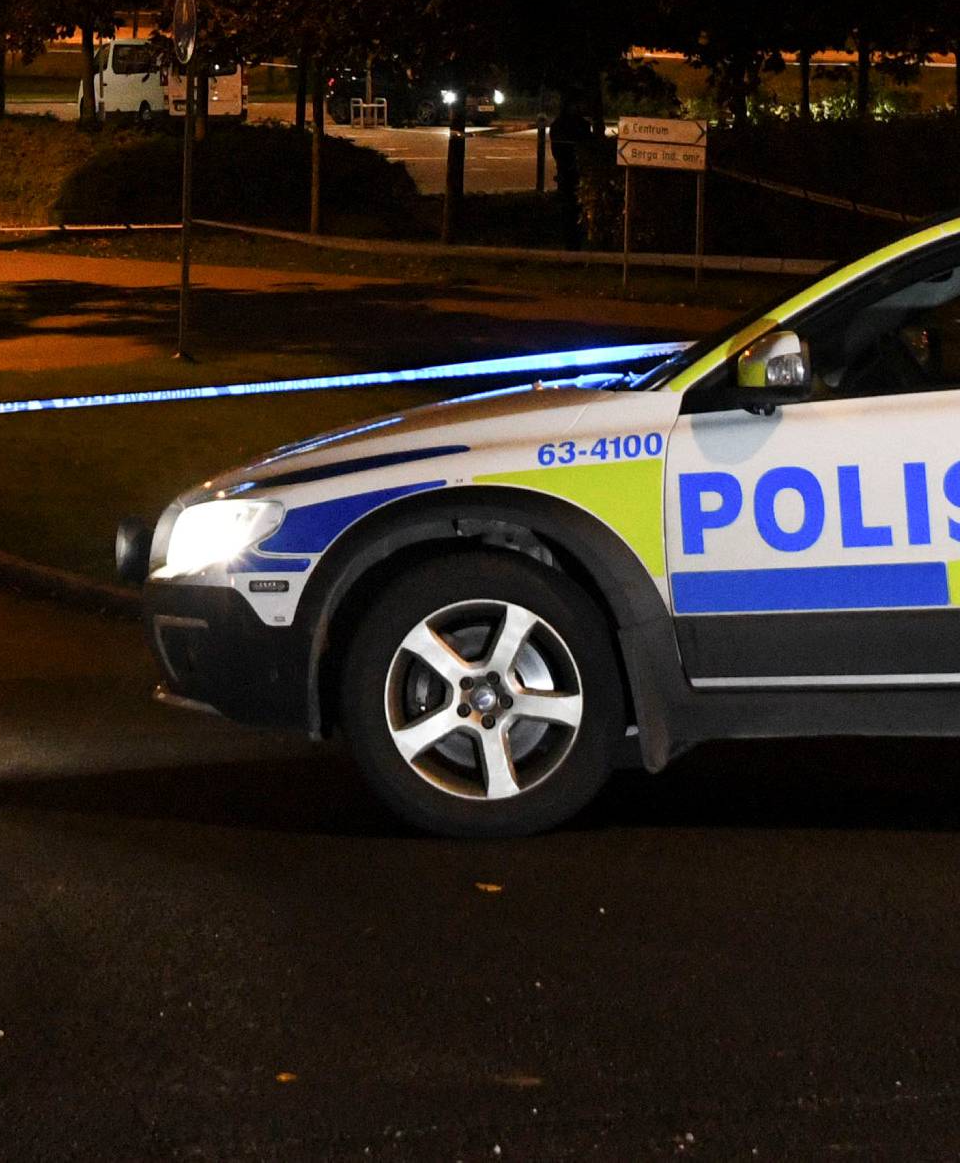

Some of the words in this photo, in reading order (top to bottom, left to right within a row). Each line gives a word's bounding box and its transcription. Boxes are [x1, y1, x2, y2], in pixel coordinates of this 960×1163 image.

[632, 123, 669, 135] Centrum
[538, 433, 663, 466] 63-4100
[679, 460, 960, 555] POLI
